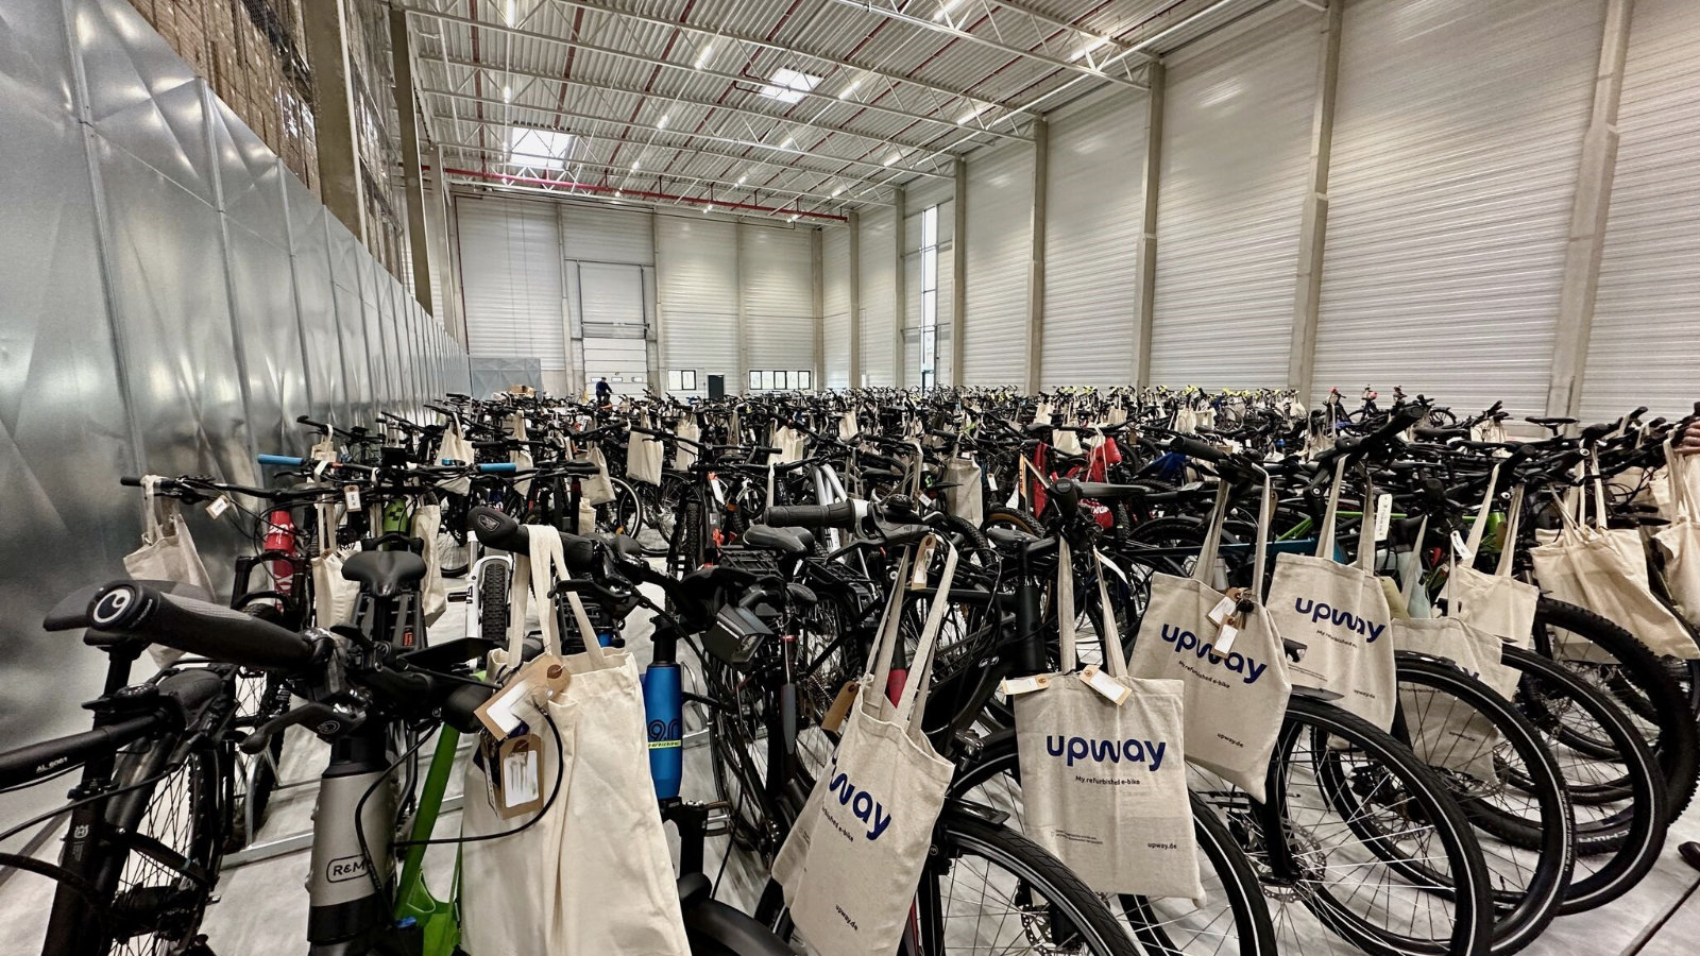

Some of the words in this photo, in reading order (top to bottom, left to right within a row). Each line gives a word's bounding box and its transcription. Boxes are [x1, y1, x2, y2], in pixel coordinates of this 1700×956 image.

[1161, 623, 1268, 684] upway
[1217, 733, 1244, 748] upway.de
[1046, 735, 1166, 771] upway
[1086, 777, 1121, 786] refurbished
[829, 756, 892, 841] way
[1147, 842, 1177, 850] upway.de
[333, 861, 366, 876] R&M
